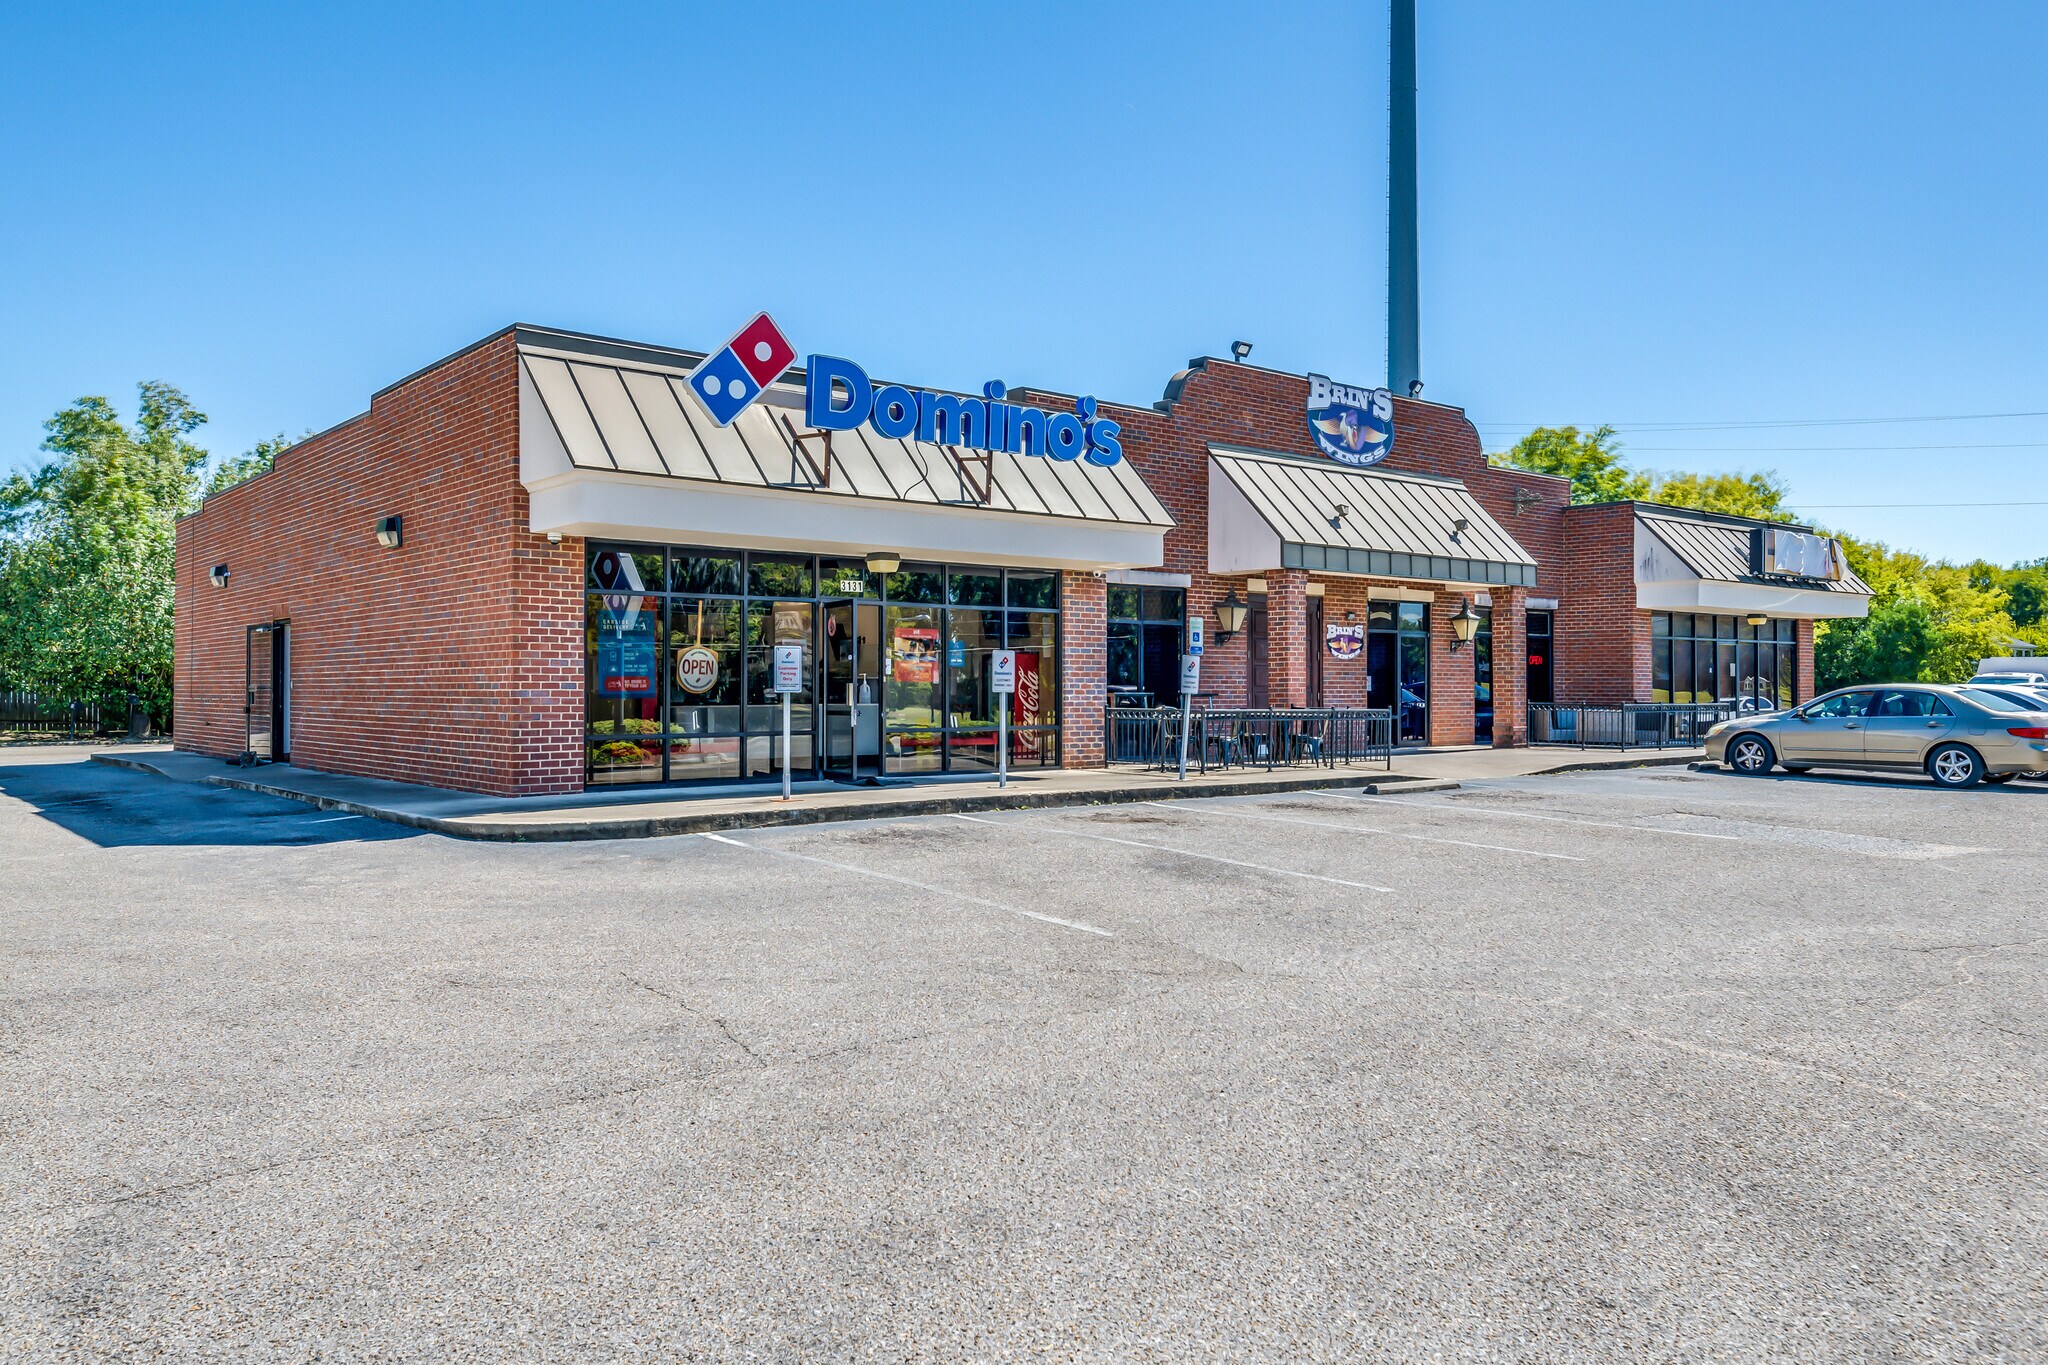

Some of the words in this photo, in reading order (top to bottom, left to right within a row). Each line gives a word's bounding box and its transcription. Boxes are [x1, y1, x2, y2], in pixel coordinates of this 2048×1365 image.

[1307, 373, 1393, 422] BRIN'S
[806, 354, 1122, 467] Domino's
[1318, 434, 1386, 464] WINGS
[841, 581, 862, 592] 3131
[1326, 624, 1364, 640] BRIN'S
[682, 659, 714, 675] OPEN
[1529, 655, 1543, 665] OPEN
[1018, 665, 1039, 750] Coca-Cola
